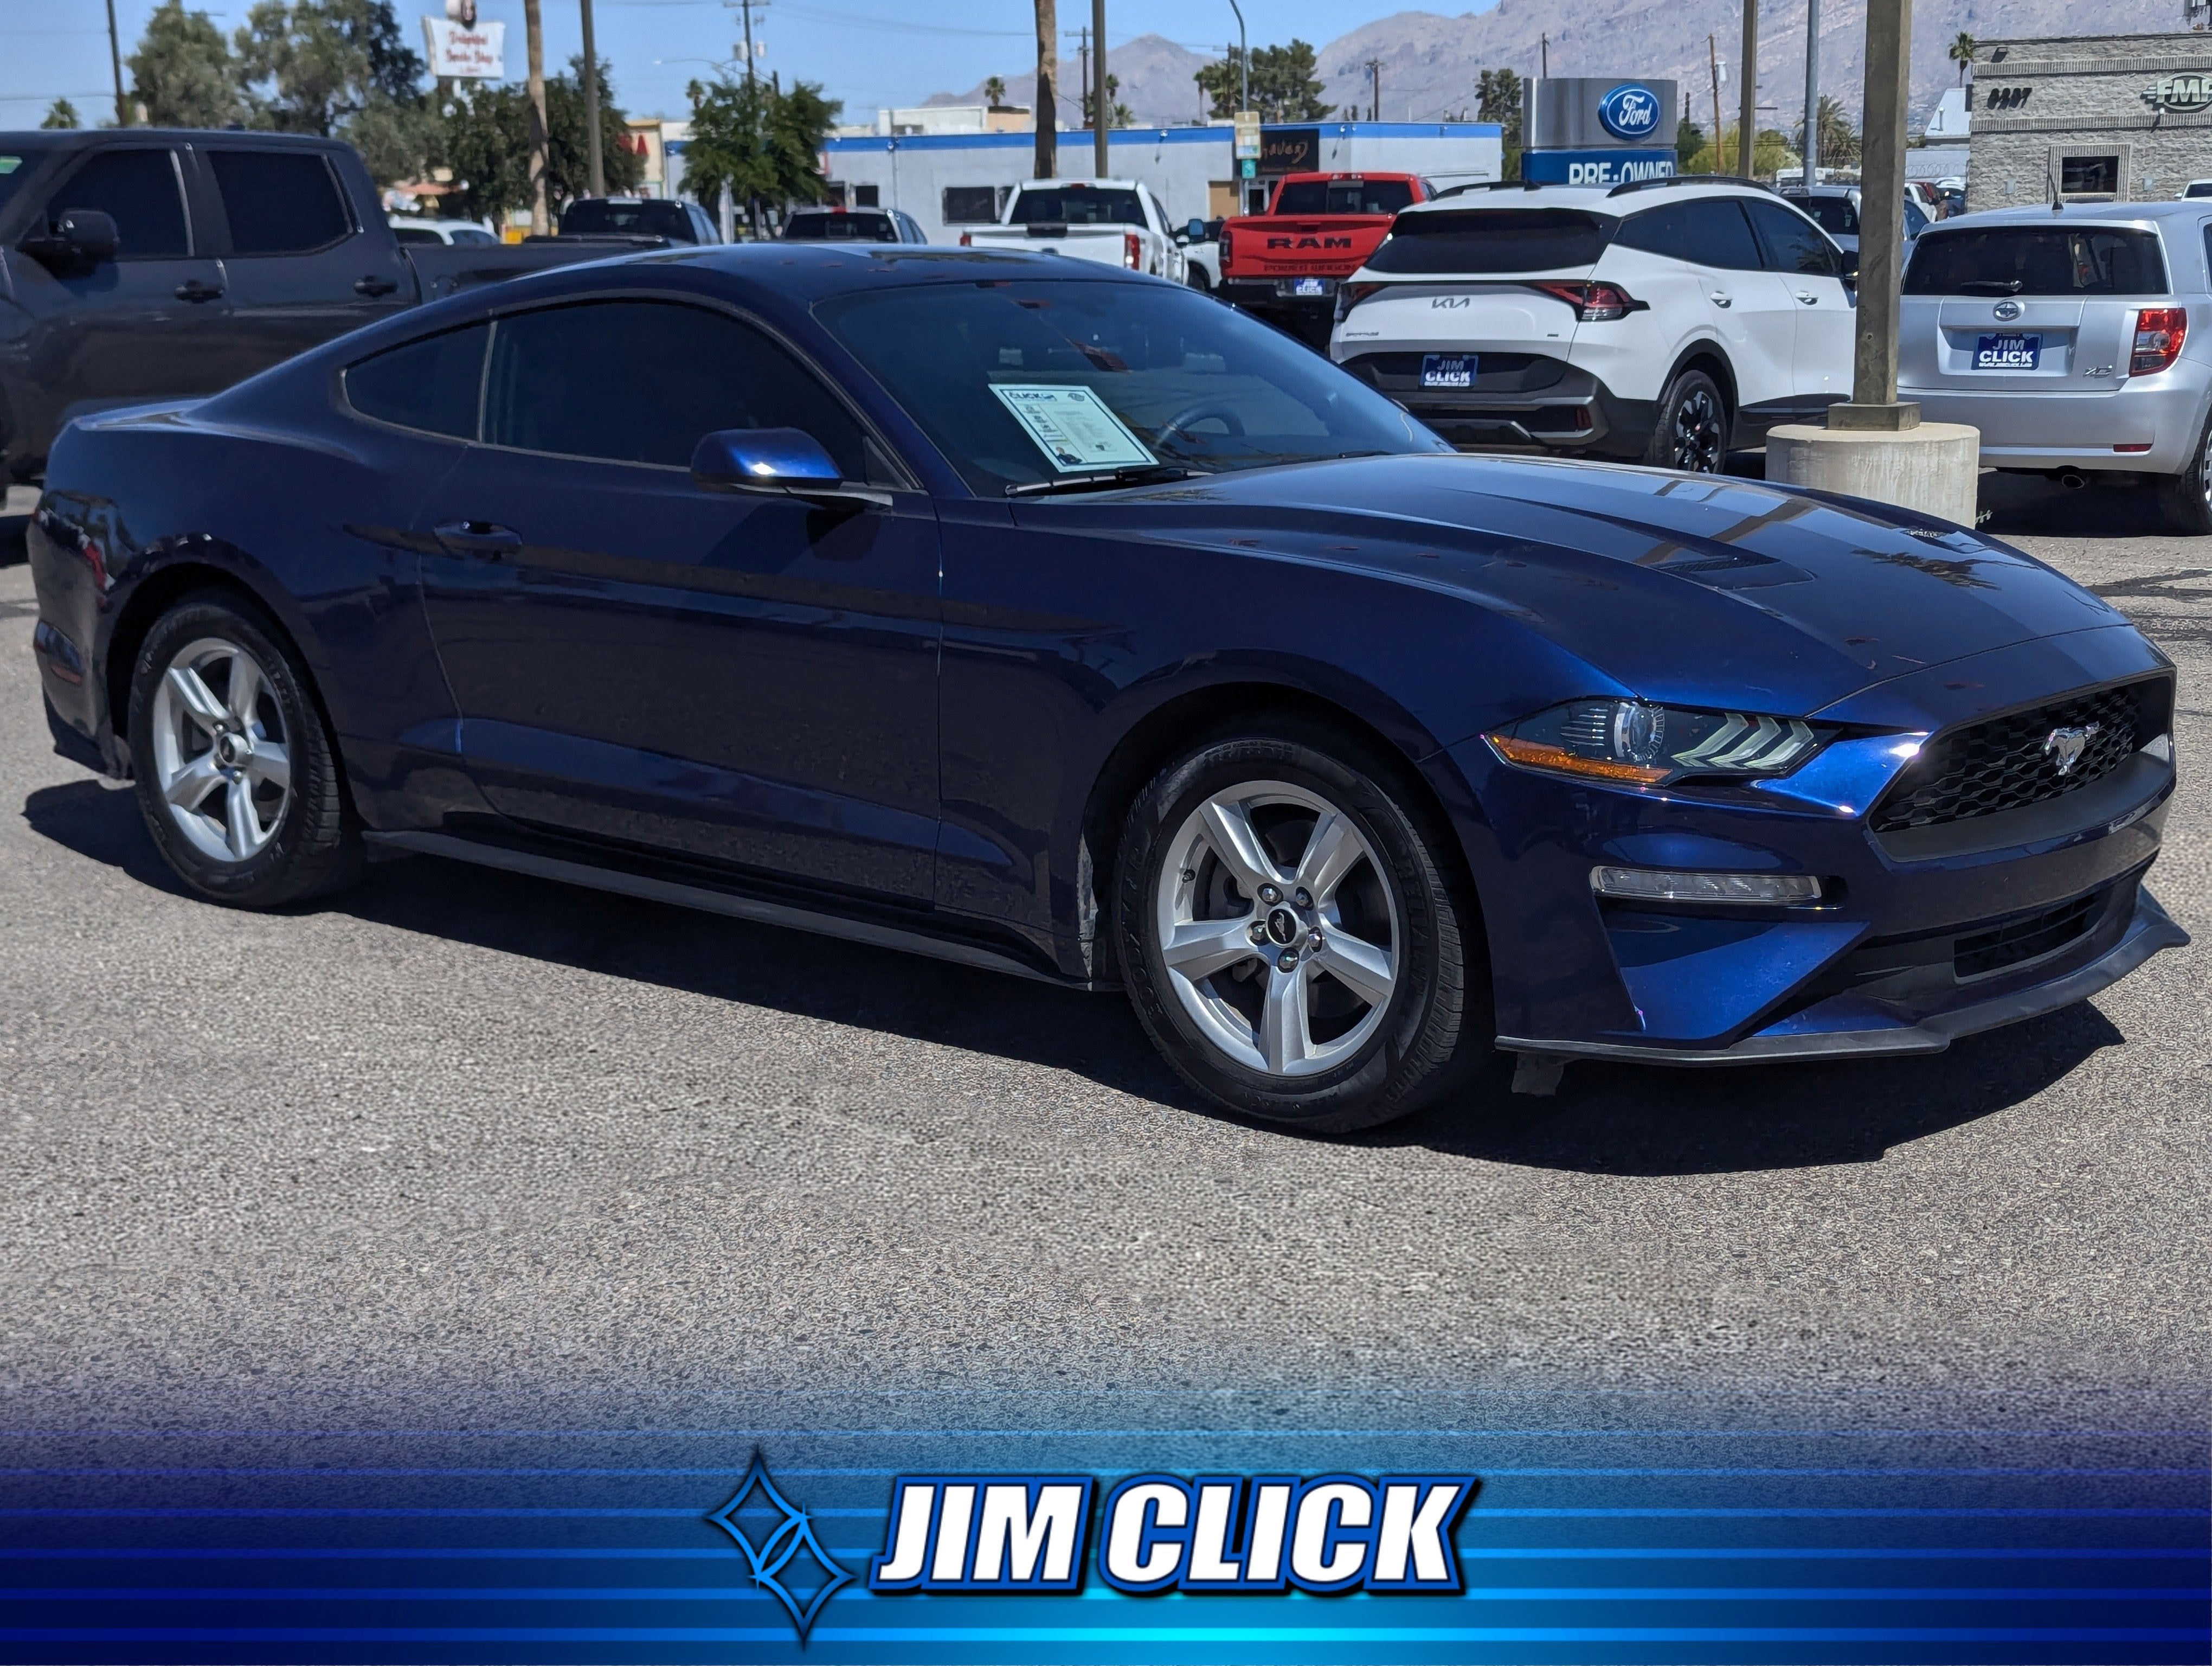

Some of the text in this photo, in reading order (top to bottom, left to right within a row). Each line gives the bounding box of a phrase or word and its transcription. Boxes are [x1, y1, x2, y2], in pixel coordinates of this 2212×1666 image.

[1619, 94, 1652, 126] Ford
[1268, 238, 1352, 249] RAM
[1992, 339, 2025, 350] JIM
[1979, 350, 2033, 362] CLICK
[1437, 360, 1464, 370] JIM
[1425, 371, 1470, 382] CLICK
